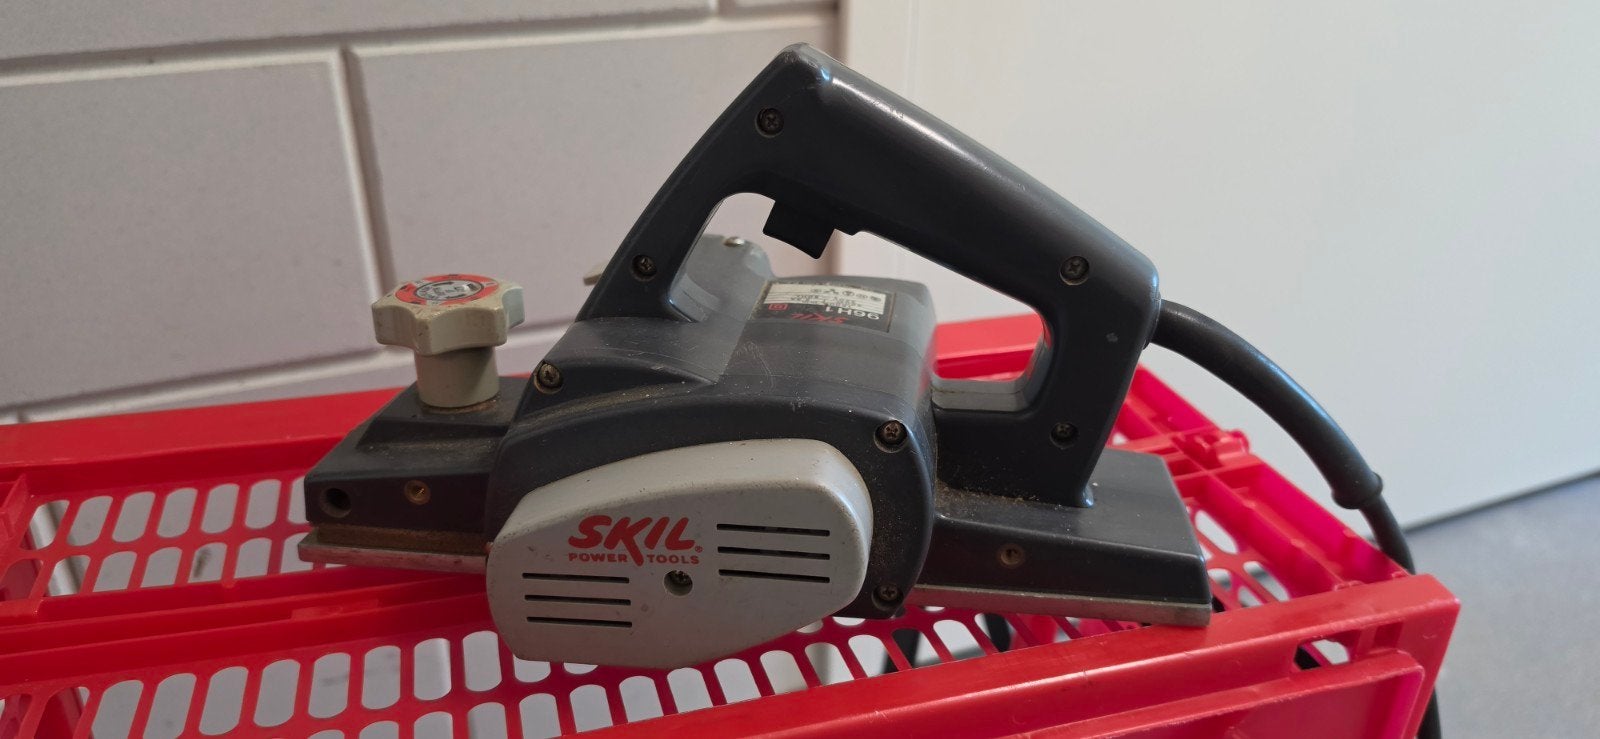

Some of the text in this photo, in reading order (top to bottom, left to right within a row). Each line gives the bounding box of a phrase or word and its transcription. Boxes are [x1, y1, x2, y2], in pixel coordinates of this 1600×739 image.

[791, 312, 849, 325] SKIL
[568, 514, 695, 566] SKIL
[568, 552, 700, 565] POWER TOOLS
